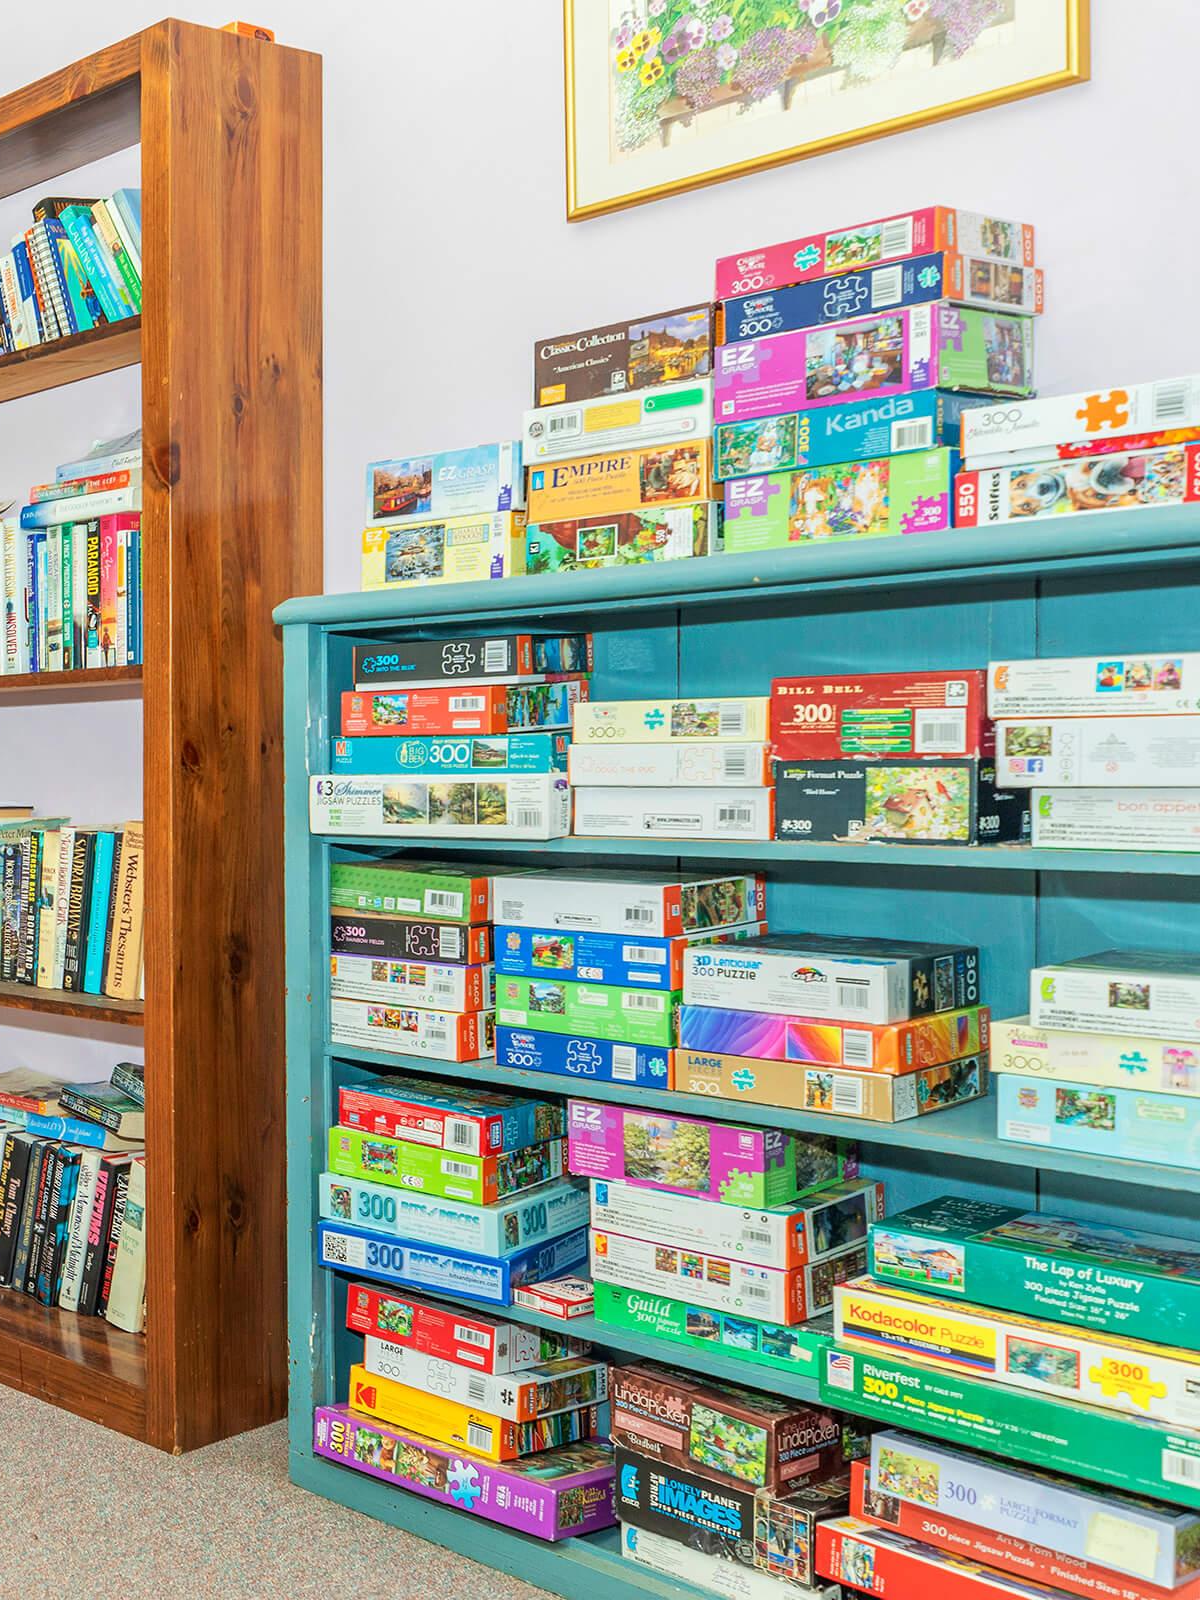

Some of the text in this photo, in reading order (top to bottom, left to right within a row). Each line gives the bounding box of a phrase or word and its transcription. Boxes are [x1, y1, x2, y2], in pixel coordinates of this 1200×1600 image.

[731, 276, 764, 294] 300
[739, 319, 772, 337] 300
[940, 309, 959, 330] EZ
[540, 331, 625, 360] Classics Collection
[721, 343, 756, 368] EZ
[721, 361, 757, 375] GRASP
[825, 397, 914, 437] Kanda
[981, 408, 1023, 428] 300
[438, 463, 497, 482] EZ GRASP
[552, 456, 633, 489] EMPIRE
[730, 479, 764, 500] EZ
[959, 483, 975, 518] 550
[989, 472, 1001, 522] Selfies
[730, 497, 766, 508] GRASP
[365, 530, 384, 543] EZ
[87, 535, 99, 596] PARANOID
[5, 525, 17, 655] JAMES PATTERSON UNSOLVED
[376, 654, 400, 667] 300
[777, 684, 864, 696] BILL BELL
[793, 703, 833, 724] 300
[588, 726, 616, 738] 300
[407, 755, 424, 764] BEN
[408, 746, 425, 756] BIG
[429, 744, 471, 764] 300
[784, 769, 865, 782] Large Format Puzzle
[335, 780, 382, 797] Shimmer
[316, 796, 382, 807] JIGSAW PUZZLES
[1117, 800, 1147, 812] bon
[791, 819, 813, 831] 300
[987, 815, 999, 830] 300
[5, 859, 14, 877] NORA
[30, 834, 38, 880] JEFFERSON
[68, 837, 86, 931] SANDRA BROWN
[113, 853, 139, 989] Webster's Thesaurus
[346, 926, 367, 938] 300
[26, 915, 35, 970] BONE YARD
[692, 954, 763, 971] 3D Lenticular
[692, 966, 715, 978] 300
[472, 972, 480, 1005] CEACO
[966, 955, 977, 1001] 300
[507, 1052, 534, 1067] 300
[688, 1055, 723, 1069] LARGE
[1003, 1053, 1042, 1072] 300
[689, 1080, 720, 1094] 300
[572, 1103, 601, 1126] EZ
[572, 1119, 604, 1132] GRASP
[3, 1138, 15, 1159] The
[765, 1131, 783, 1151] EZ
[0, 1159, 11, 1186] Bear
[46, 1153, 56, 1185] ROBERT
[48, 1160, 65, 1220] ROBERT LUDLUM
[114, 1182, 129, 1212] ANNE
[0, 1177, 21, 1237] Tom Clancy
[73, 1190, 89, 1231] Memories
[87, 1169, 109, 1247] VICTIMS
[359, 1191, 397, 1223] 300
[522, 1203, 548, 1236] 300
[71, 1231, 82, 1242] of
[65, 1241, 83, 1281] Midnight
[368, 1241, 405, 1271] 300
[1023, 1256, 1145, 1294] The Lap of Luxury
[627, 1294, 674, 1318] Guild
[1023, 1279, 1140, 1313] 300 piece Jigsaw Puzzle
[1034, 1294, 1067, 1308] Finished
[634, 1311, 657, 1325] 300
[848, 1302, 937, 1338] Kodacolor
[940, 1326, 986, 1350] Puzzle
[380, 1341, 405, 1357] LARGE
[377, 1361, 400, 1377] 300
[863, 1362, 921, 1390] Riverfest
[1107, 1361, 1144, 1381] 300
[623, 1381, 665, 1402] the art of
[862, 1376, 985, 1424] 300 Jigsaw Puzzle
[329, 1420, 346, 1455] 300
[649, 1471, 659, 1507] AFRICA
[664, 1478, 742, 1512] LONELY PLANET
[943, 1480, 978, 1506] 300
[657, 1484, 743, 1531] IMAGES
[999, 1496, 1079, 1529] LARGE FORMAT
[999, 1507, 1038, 1527] PUZZLE
[921, 1520, 1035, 1568] 300 piece Jigsaw Puzzle
[995, 1533, 1088, 1570] Art by Tom Wood
[1050, 1565, 1122, 1598] Finished Size:
